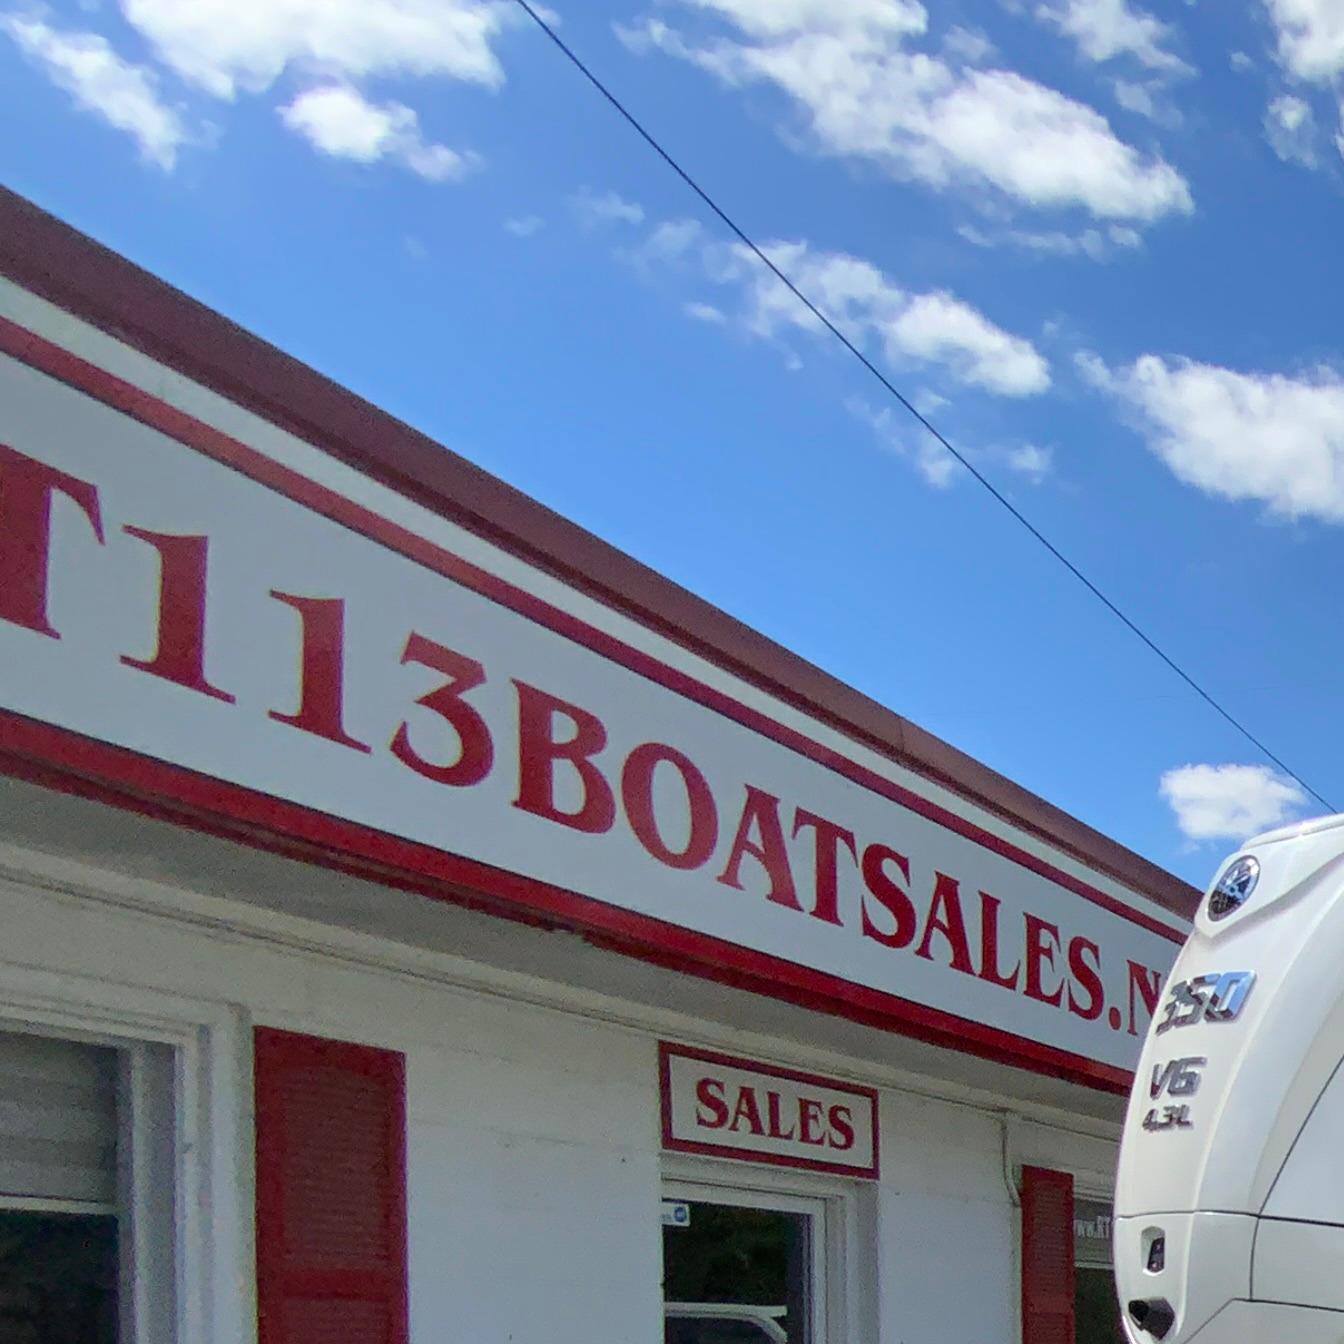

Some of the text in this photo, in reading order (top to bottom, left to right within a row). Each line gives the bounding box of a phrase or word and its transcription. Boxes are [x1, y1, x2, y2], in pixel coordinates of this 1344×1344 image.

[1155, 970, 1257, 1036] 350
[1149, 1056, 1208, 1101] V6
[695, 1077, 855, 1151] SALES
